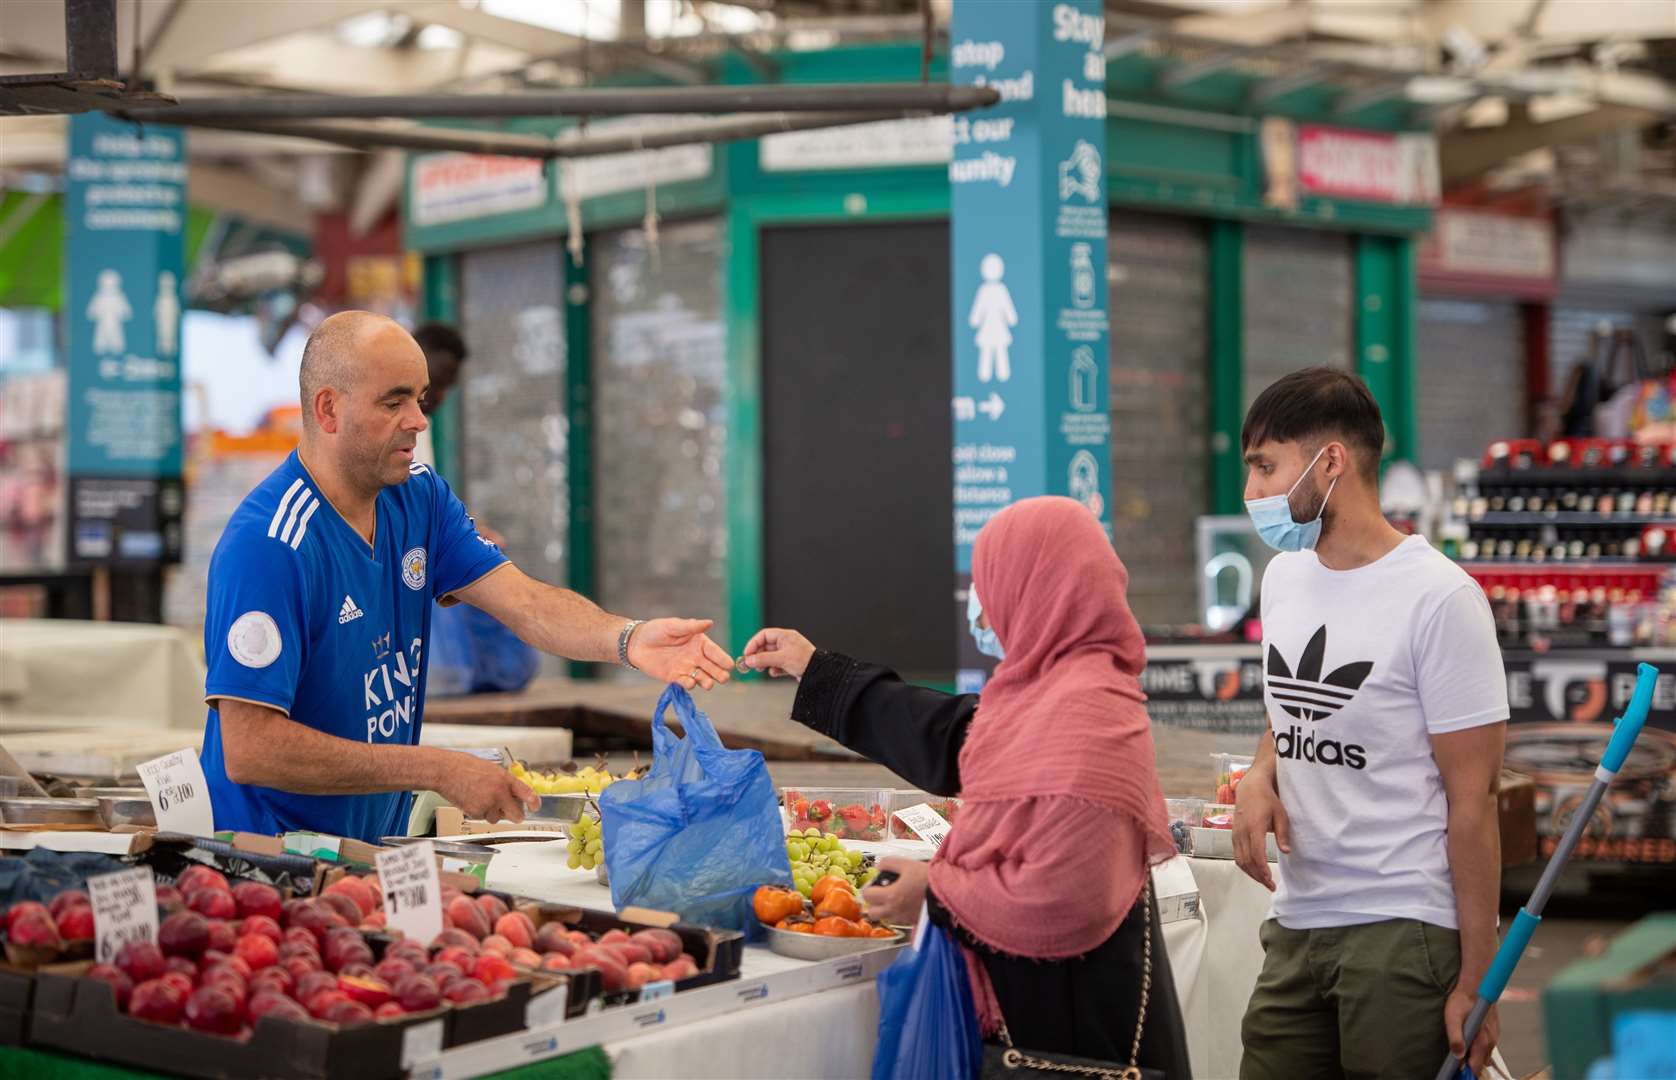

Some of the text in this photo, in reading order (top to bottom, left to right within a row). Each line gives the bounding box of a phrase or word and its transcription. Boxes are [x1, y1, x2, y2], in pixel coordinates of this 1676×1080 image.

[338, 608, 364, 624] adidas
[1272, 725, 1367, 770] didas
[159, 789, 169, 811] 6
